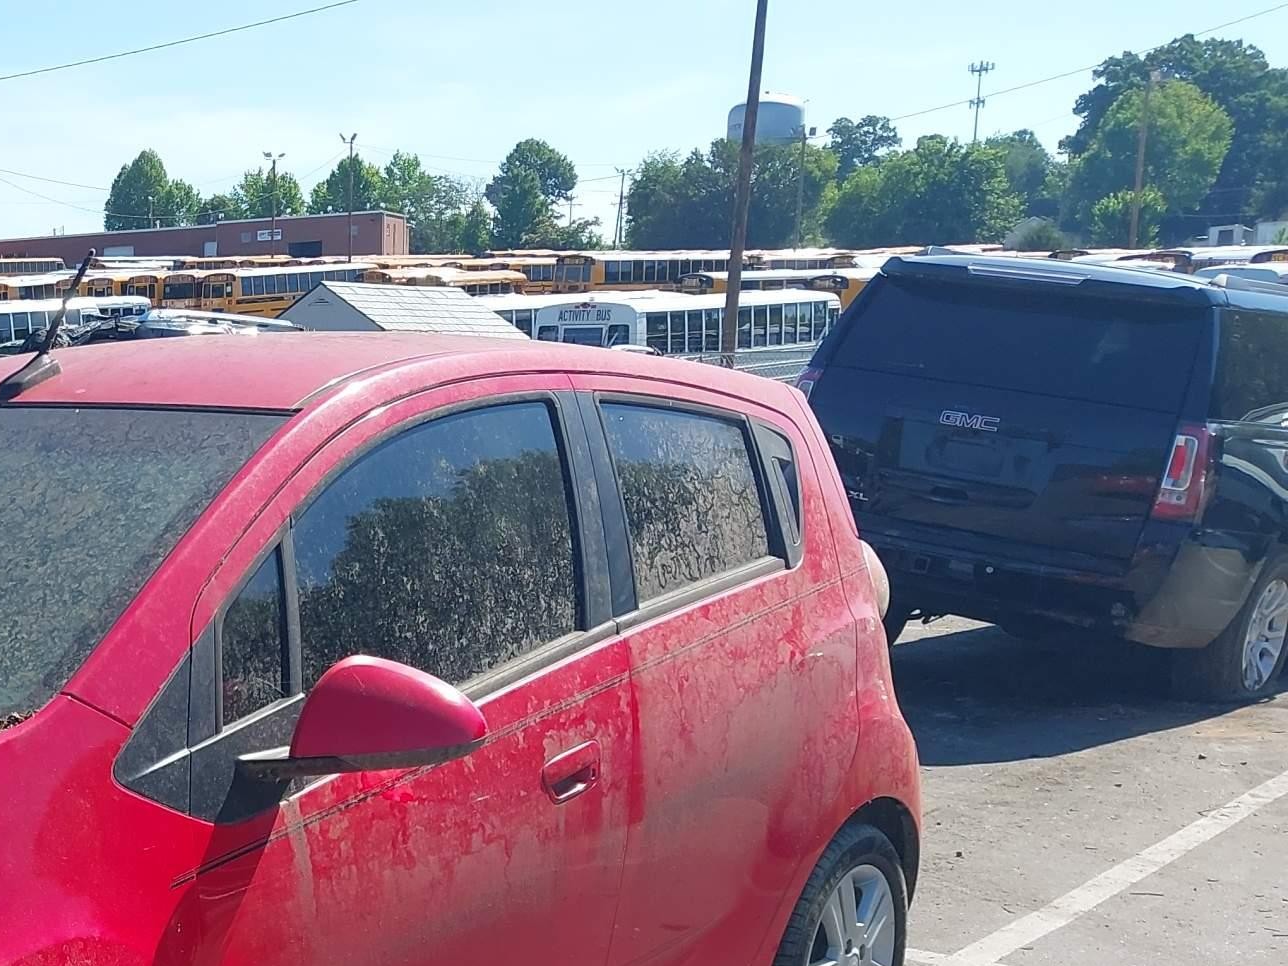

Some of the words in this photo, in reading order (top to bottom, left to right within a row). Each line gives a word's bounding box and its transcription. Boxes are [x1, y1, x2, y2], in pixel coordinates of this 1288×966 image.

[557, 309, 591, 322] ACTIVITY
[596, 309, 611, 321] BUS
[939, 410, 1001, 432] GMC
